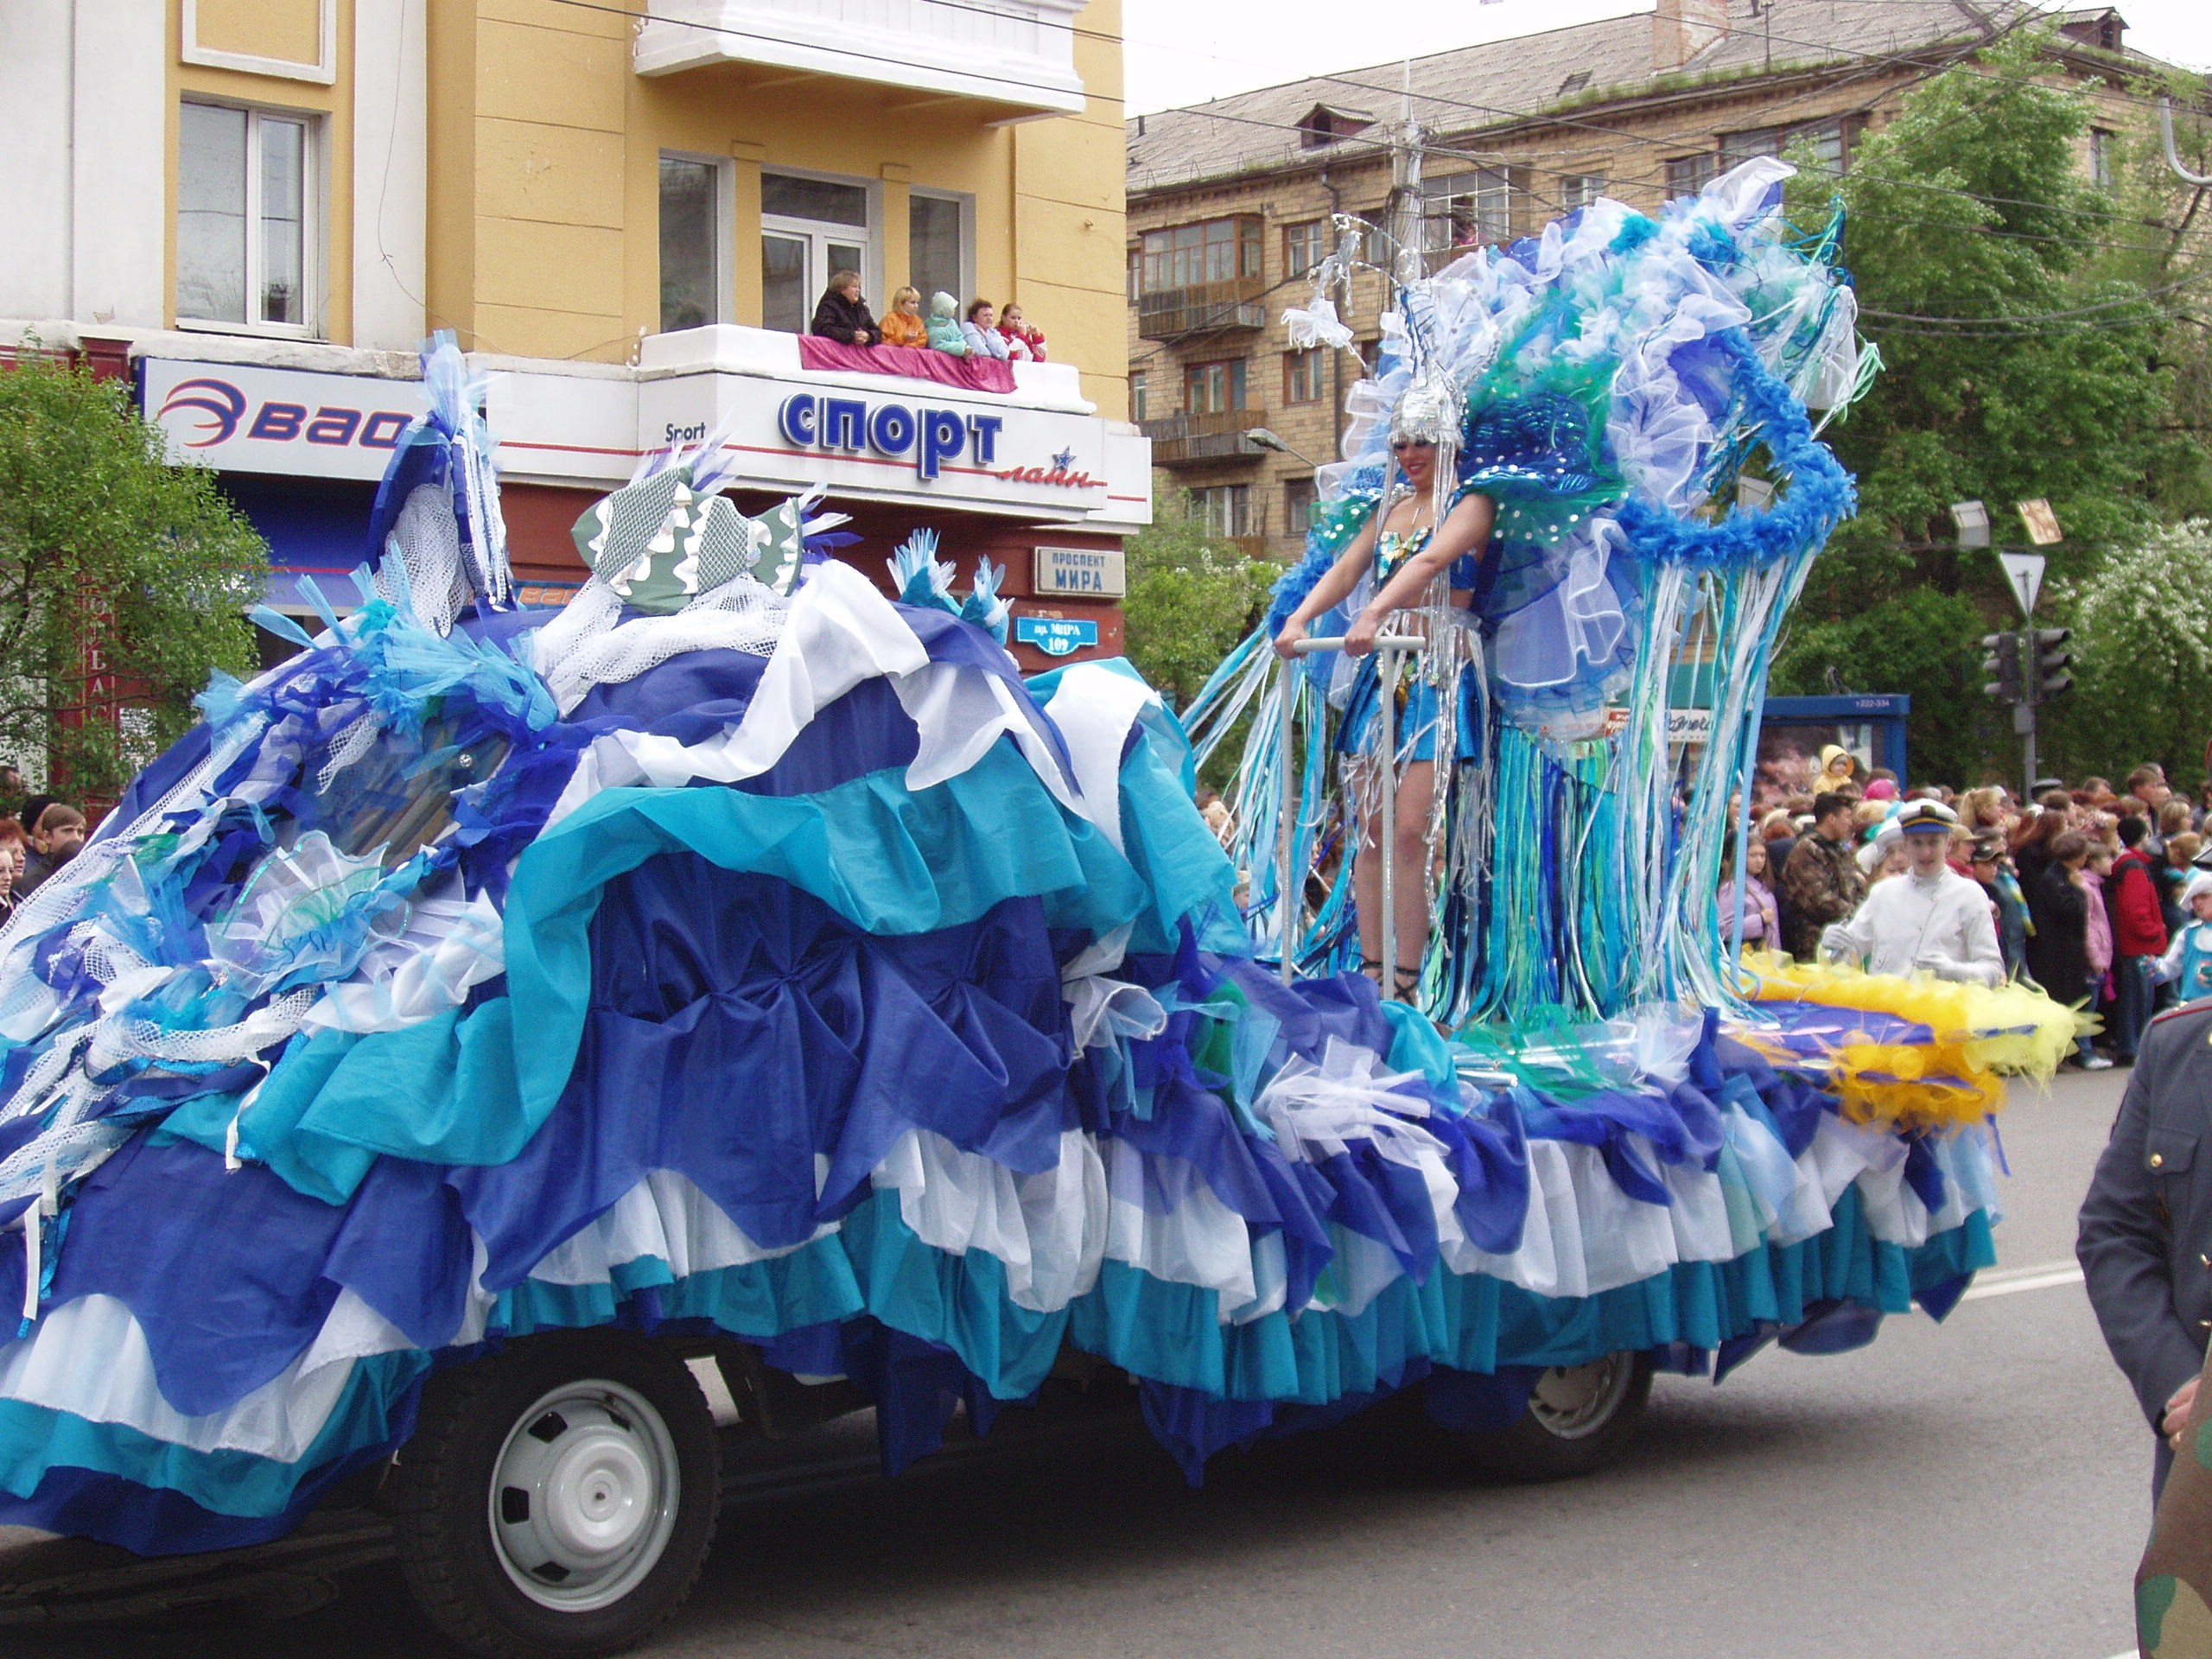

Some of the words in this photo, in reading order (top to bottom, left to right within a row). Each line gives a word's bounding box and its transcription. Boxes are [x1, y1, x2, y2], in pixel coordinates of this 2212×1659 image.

[664, 422, 706, 443] Sport
[778, 392, 1002, 480] спорт
[1052, 552, 1105, 568] ПРОСПЕКТ
[1055, 568, 1103, 591] МИРА
[1051, 623, 1081, 636] МИРА
